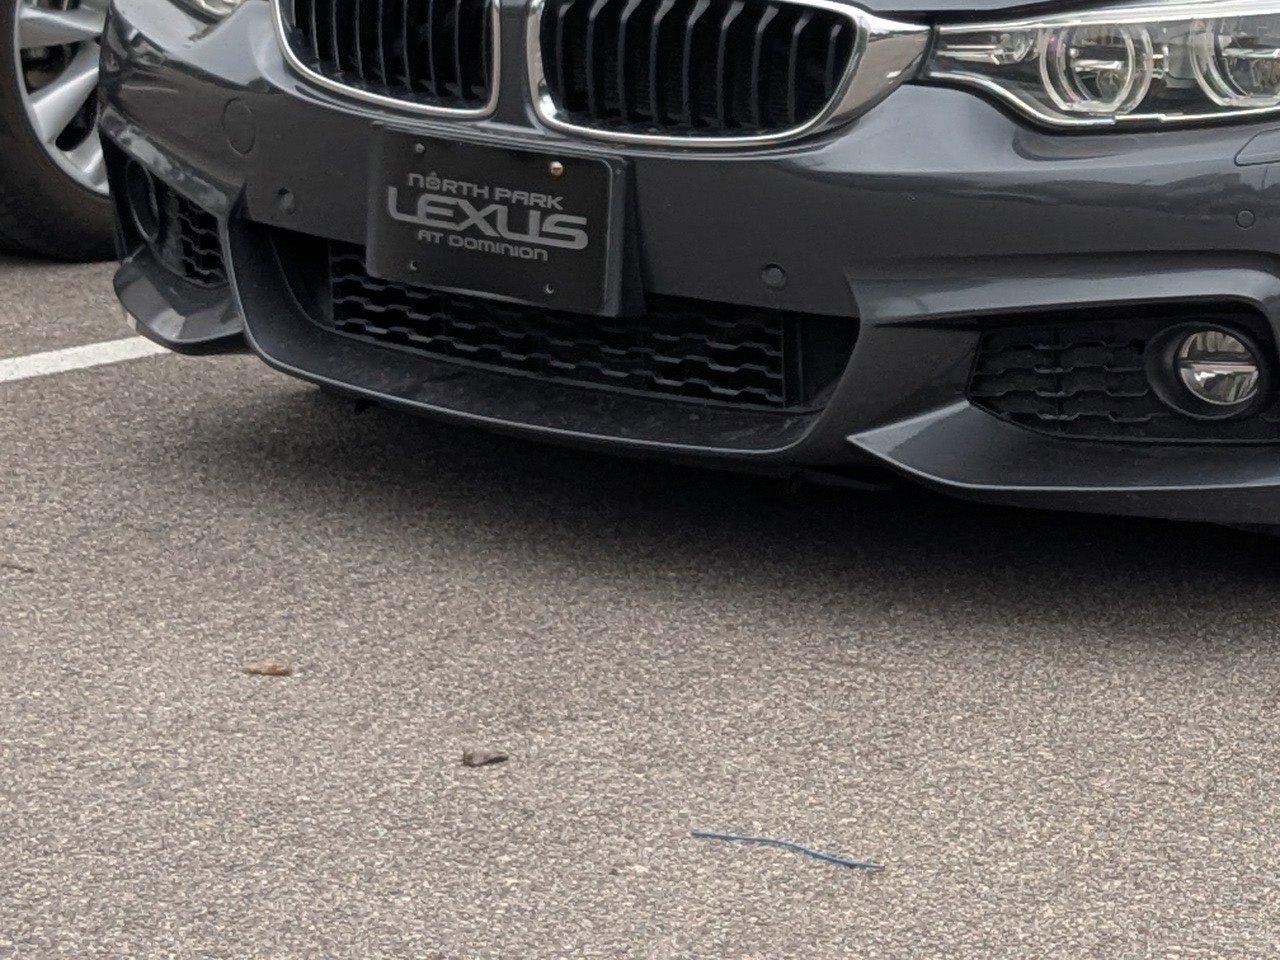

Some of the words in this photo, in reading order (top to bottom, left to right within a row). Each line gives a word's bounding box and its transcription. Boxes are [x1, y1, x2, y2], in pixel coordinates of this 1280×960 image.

[407, 173, 490, 199] NORTH
[494, 187, 564, 210] PARK
[388, 186, 589, 250] LEXUS
[417, 229, 444, 244] AT
[448, 234, 549, 261] DOMINION
